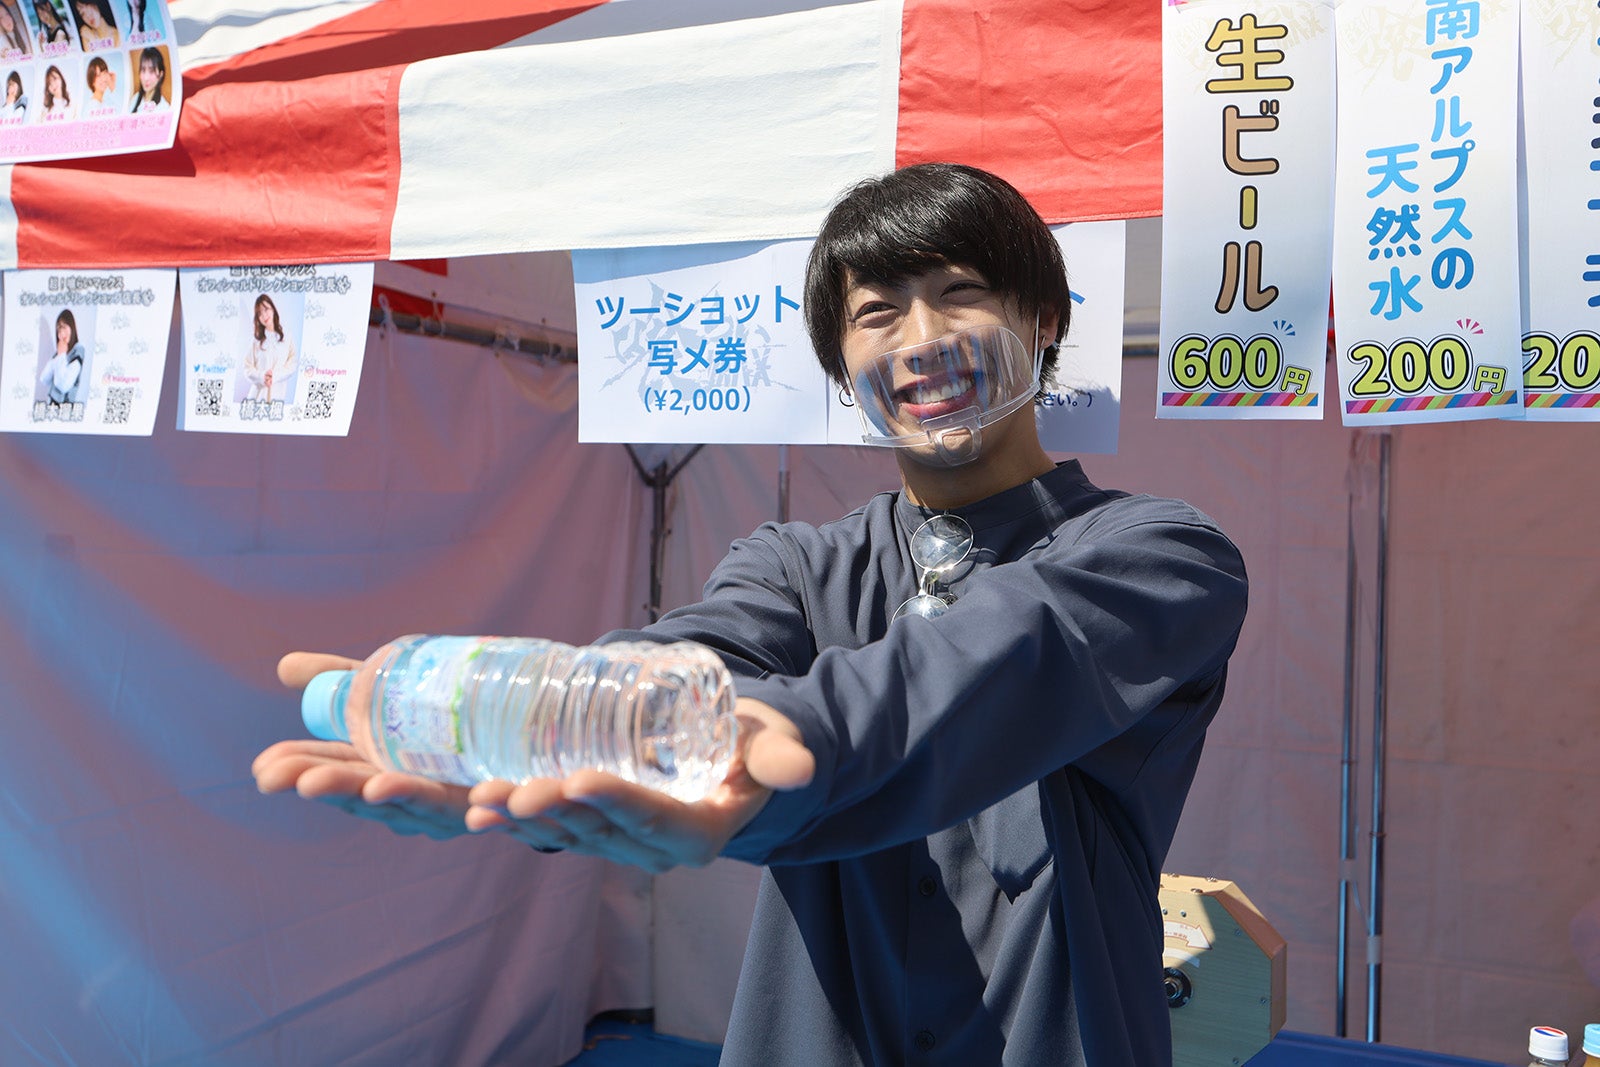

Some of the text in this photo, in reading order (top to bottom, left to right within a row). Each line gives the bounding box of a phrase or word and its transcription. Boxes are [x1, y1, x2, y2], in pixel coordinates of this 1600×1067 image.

[1205, 13, 1294, 314] 生ビール
[1425, 0, 1480, 290] 南アルプスの
[1365, 143, 1424, 321] 天然水
[595, 285, 801, 330] ツーショット
[202, 365, 227, 374] Twitter
[315, 368, 347, 377] Instagram
[647, 336, 747, 376] 写メ券
[644, 386, 751, 416] (¥2,000)
[1035, 392, 1093, 407] さい。)
